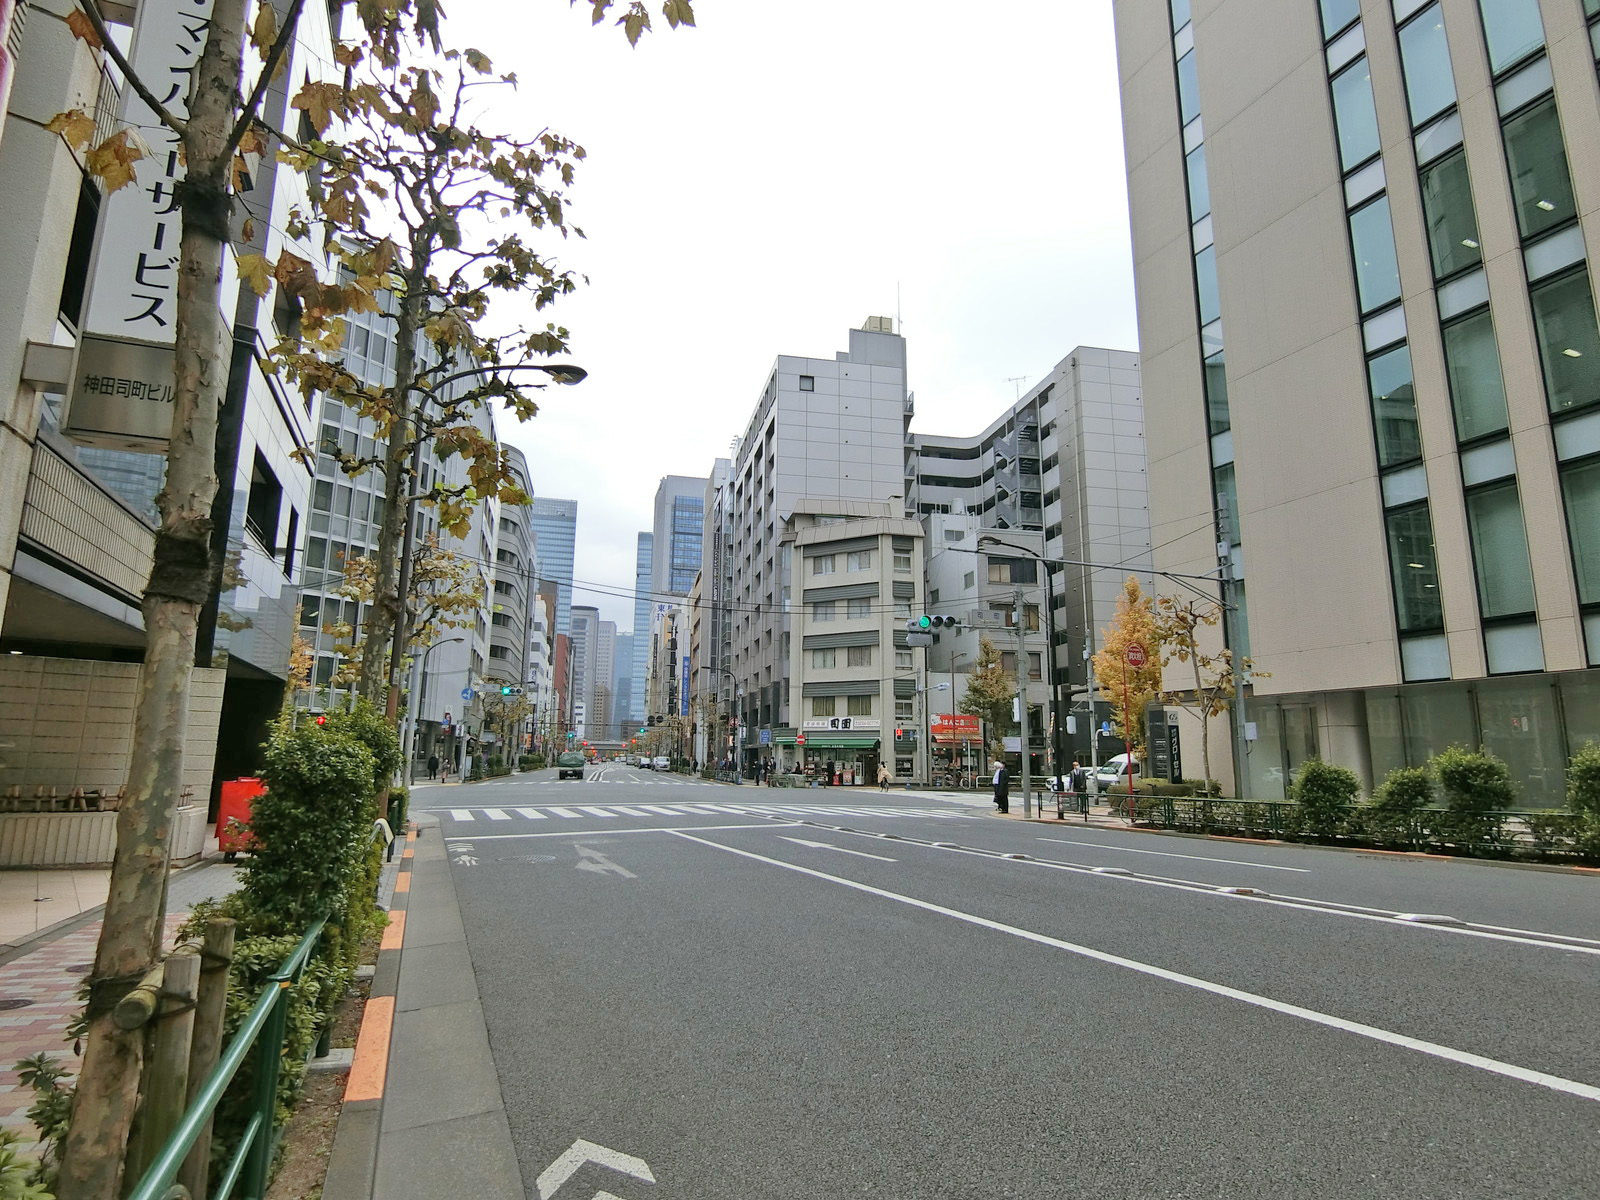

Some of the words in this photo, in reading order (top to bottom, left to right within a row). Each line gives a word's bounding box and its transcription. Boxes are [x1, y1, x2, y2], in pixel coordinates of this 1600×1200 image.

[83, 374, 176, 404] 神田司町ビル
